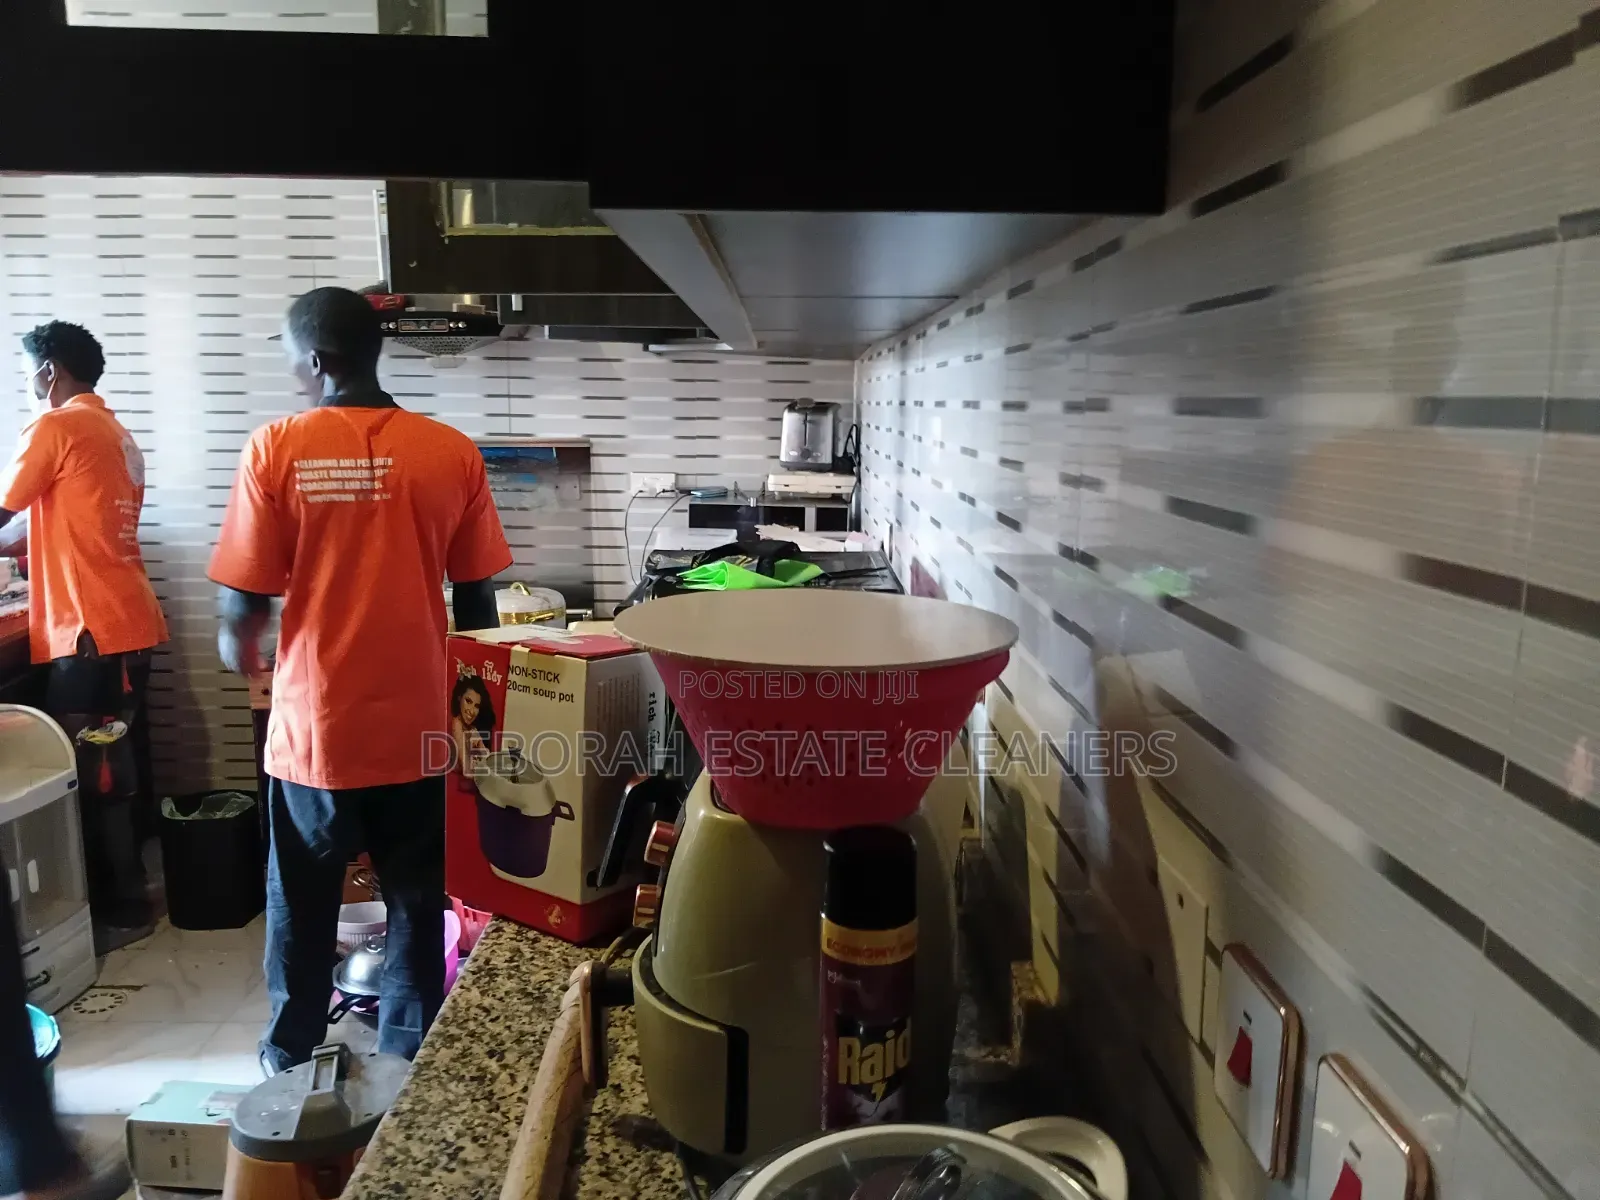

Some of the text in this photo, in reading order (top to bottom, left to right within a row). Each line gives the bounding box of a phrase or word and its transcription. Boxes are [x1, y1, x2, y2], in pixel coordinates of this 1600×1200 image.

[339, 459, 356, 467] AND
[299, 469, 329, 480] WASTE
[482, 666, 503, 686] lady
[507, 664, 560, 684] NON-STICK
[506, 679, 575, 704] 20cm soup pot
[648, 691, 657, 722] rich
[838, 1016, 912, 1085] Raid
